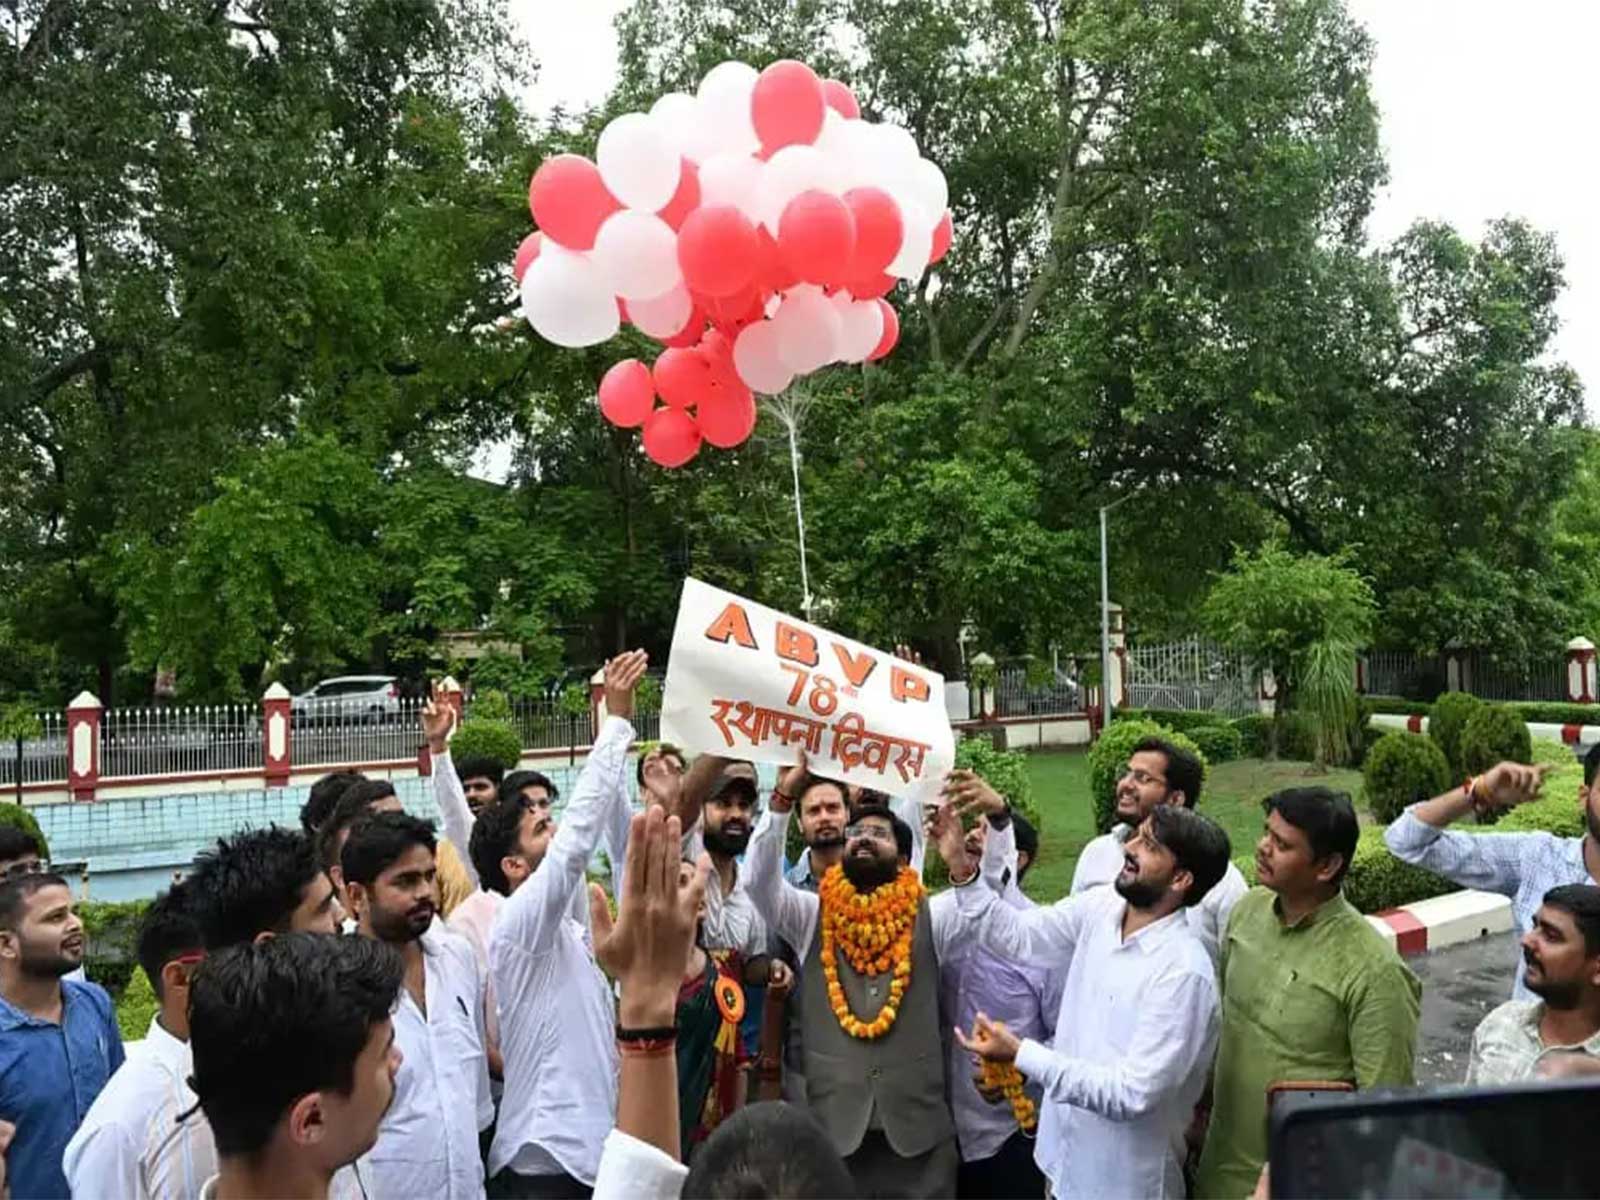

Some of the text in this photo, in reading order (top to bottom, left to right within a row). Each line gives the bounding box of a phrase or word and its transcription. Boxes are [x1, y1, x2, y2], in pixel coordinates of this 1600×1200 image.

[781, 662, 838, 716] 78
[711, 699, 932, 783] स्थापना दिवस
